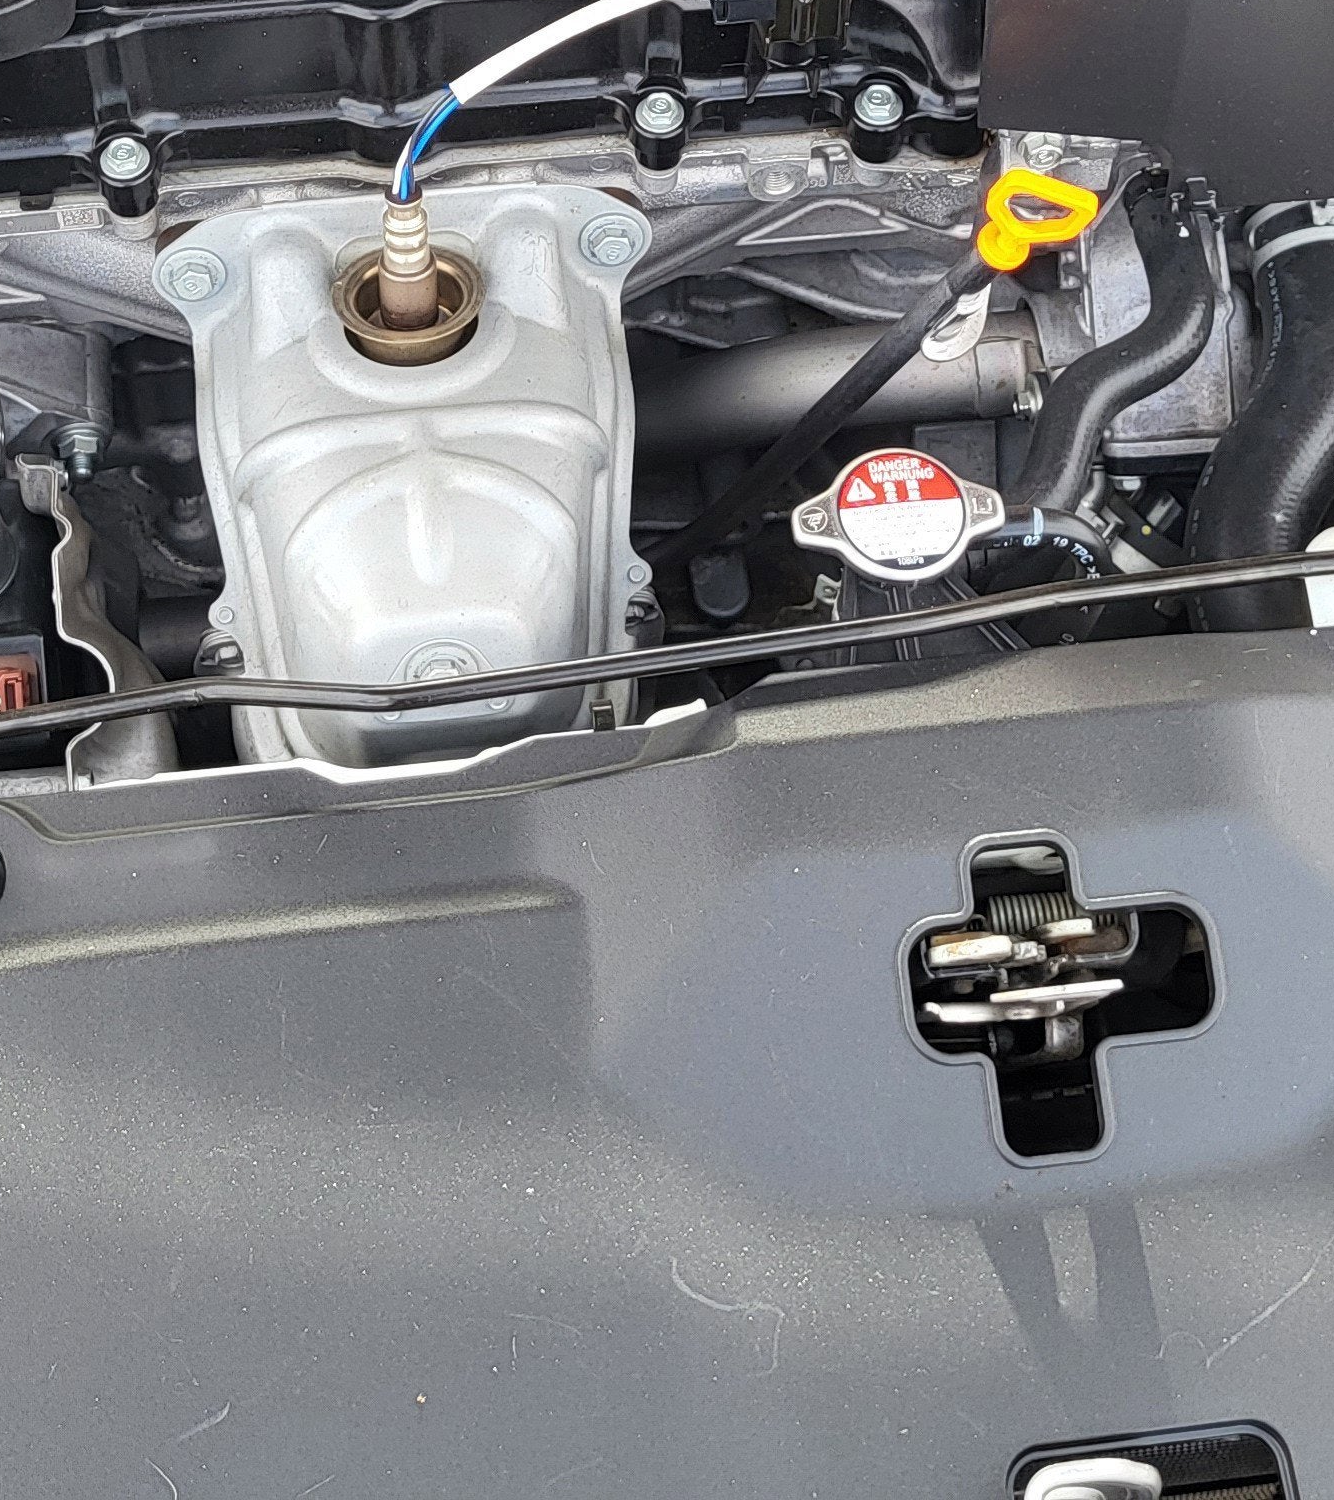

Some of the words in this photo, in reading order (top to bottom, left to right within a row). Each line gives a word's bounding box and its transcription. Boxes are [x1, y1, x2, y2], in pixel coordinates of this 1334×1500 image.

[867, 457, 921, 473] DANGER
[870, 466, 936, 484] WARNUNG
[1023, 534, 1042, 547] 02
[1052, 536, 1069, 547] 19
[1070, 542, 1095, 564] TPC
